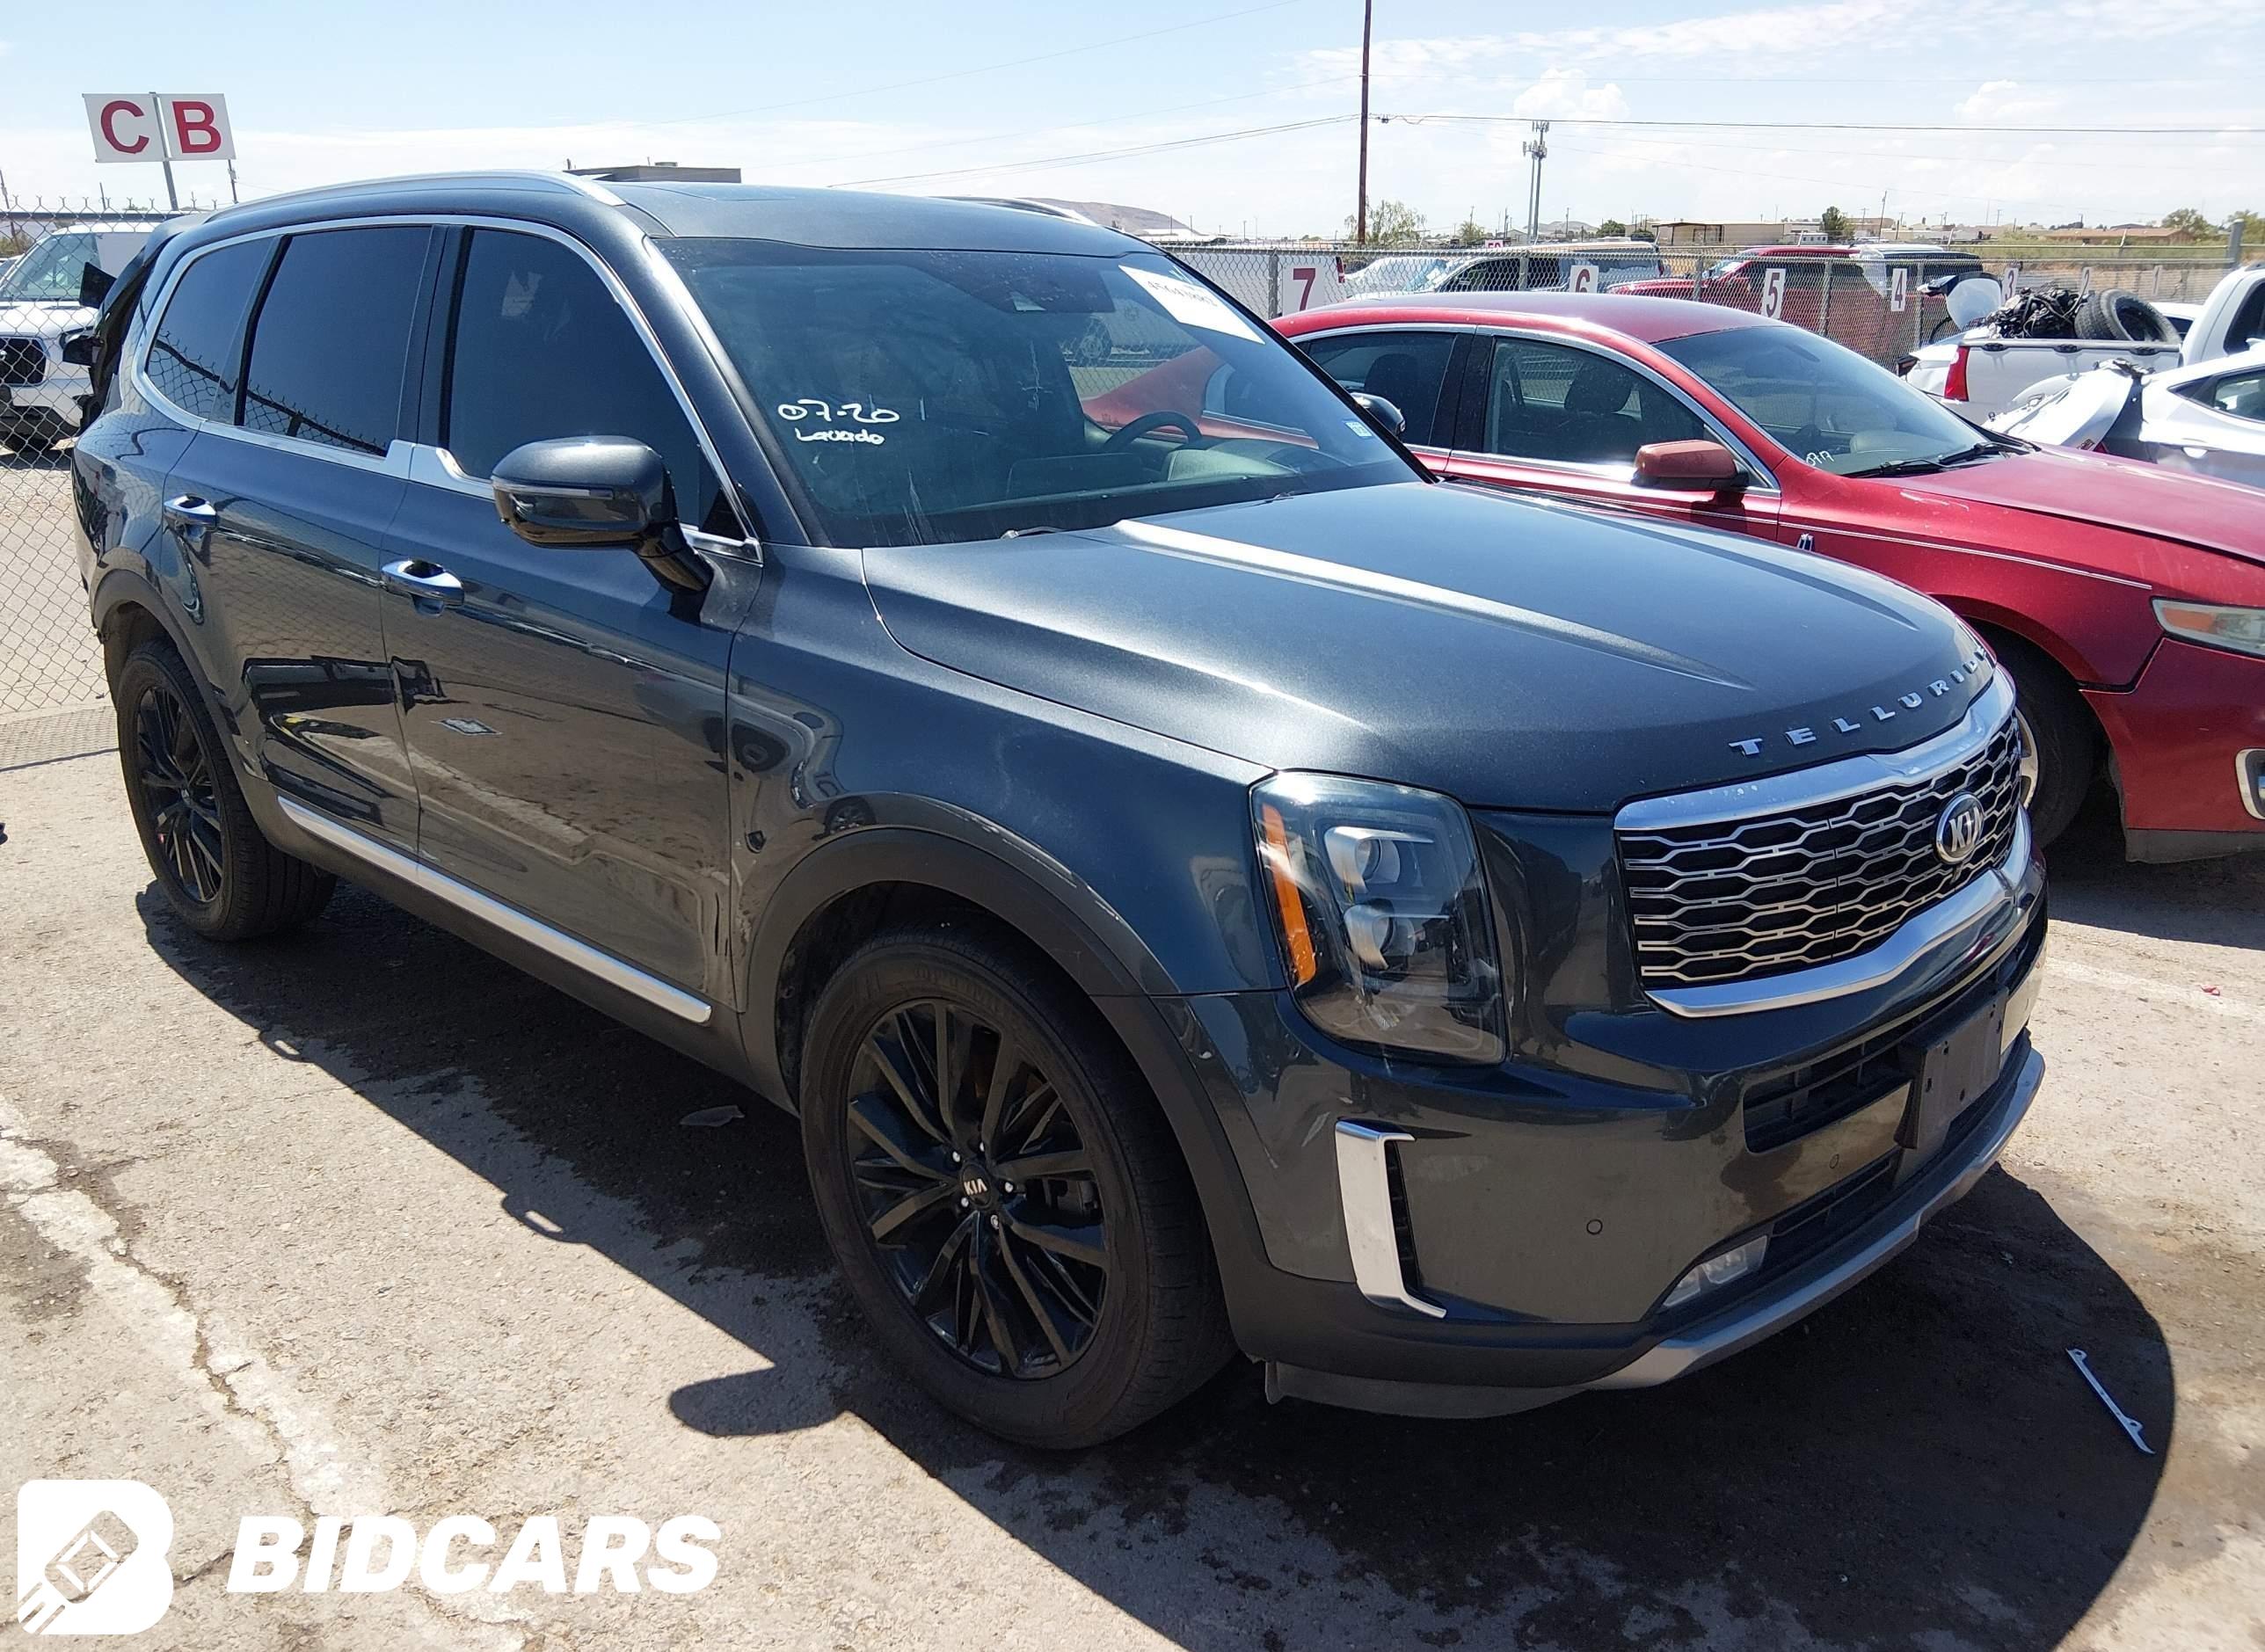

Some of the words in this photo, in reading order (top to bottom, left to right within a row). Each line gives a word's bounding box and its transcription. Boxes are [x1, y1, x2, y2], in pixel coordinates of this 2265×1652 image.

[100, 100, 149, 154] C
[171, 101, 222, 154] B
[1293, 268, 1315, 311] 7
[1576, 269, 1590, 293] 6
[1766, 273, 1780, 317] 5
[1894, 271, 1903, 309] 4
[2005, 270, 2014, 301] 3
[778, 399, 899, 423] 07-20
[1729, 645, 1986, 757] TELLURIDE
[1948, 806, 1983, 852] KIA
[964, 1178, 987, 1196] KIA
